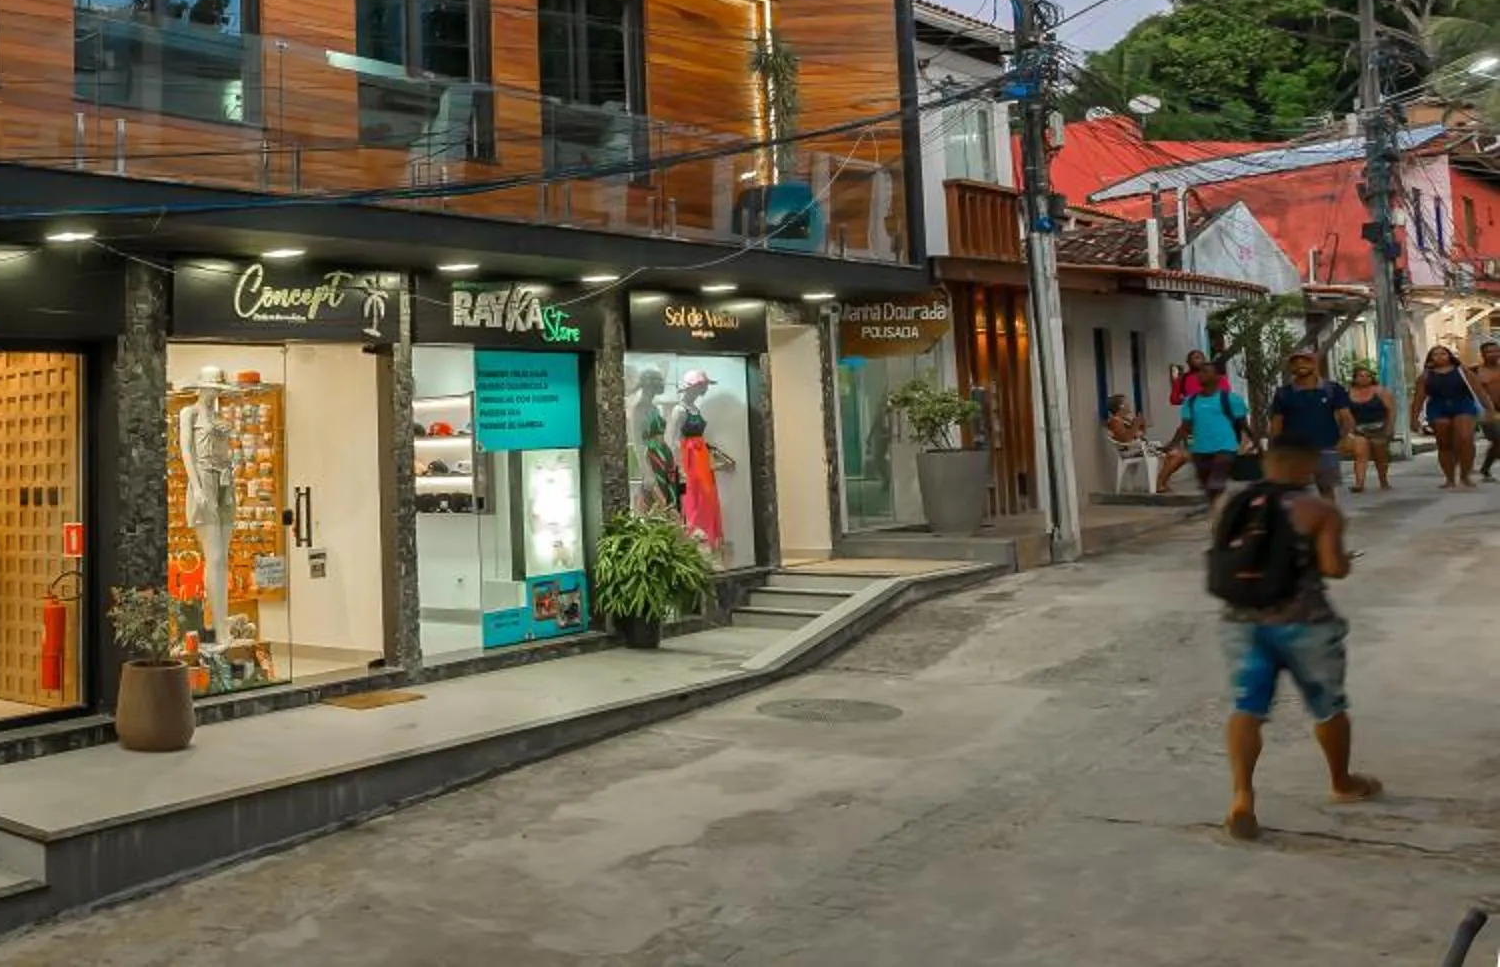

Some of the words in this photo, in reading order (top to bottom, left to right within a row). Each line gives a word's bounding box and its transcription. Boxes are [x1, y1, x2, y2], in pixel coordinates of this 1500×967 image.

[234, 263, 354, 320] Concept
[665, 306, 685, 326] Sol
[687, 306, 704, 327] de
[883, 300, 948, 321] Dourada
[542, 305, 581, 342] Store
[861, 326, 919, 339] POUSADA
